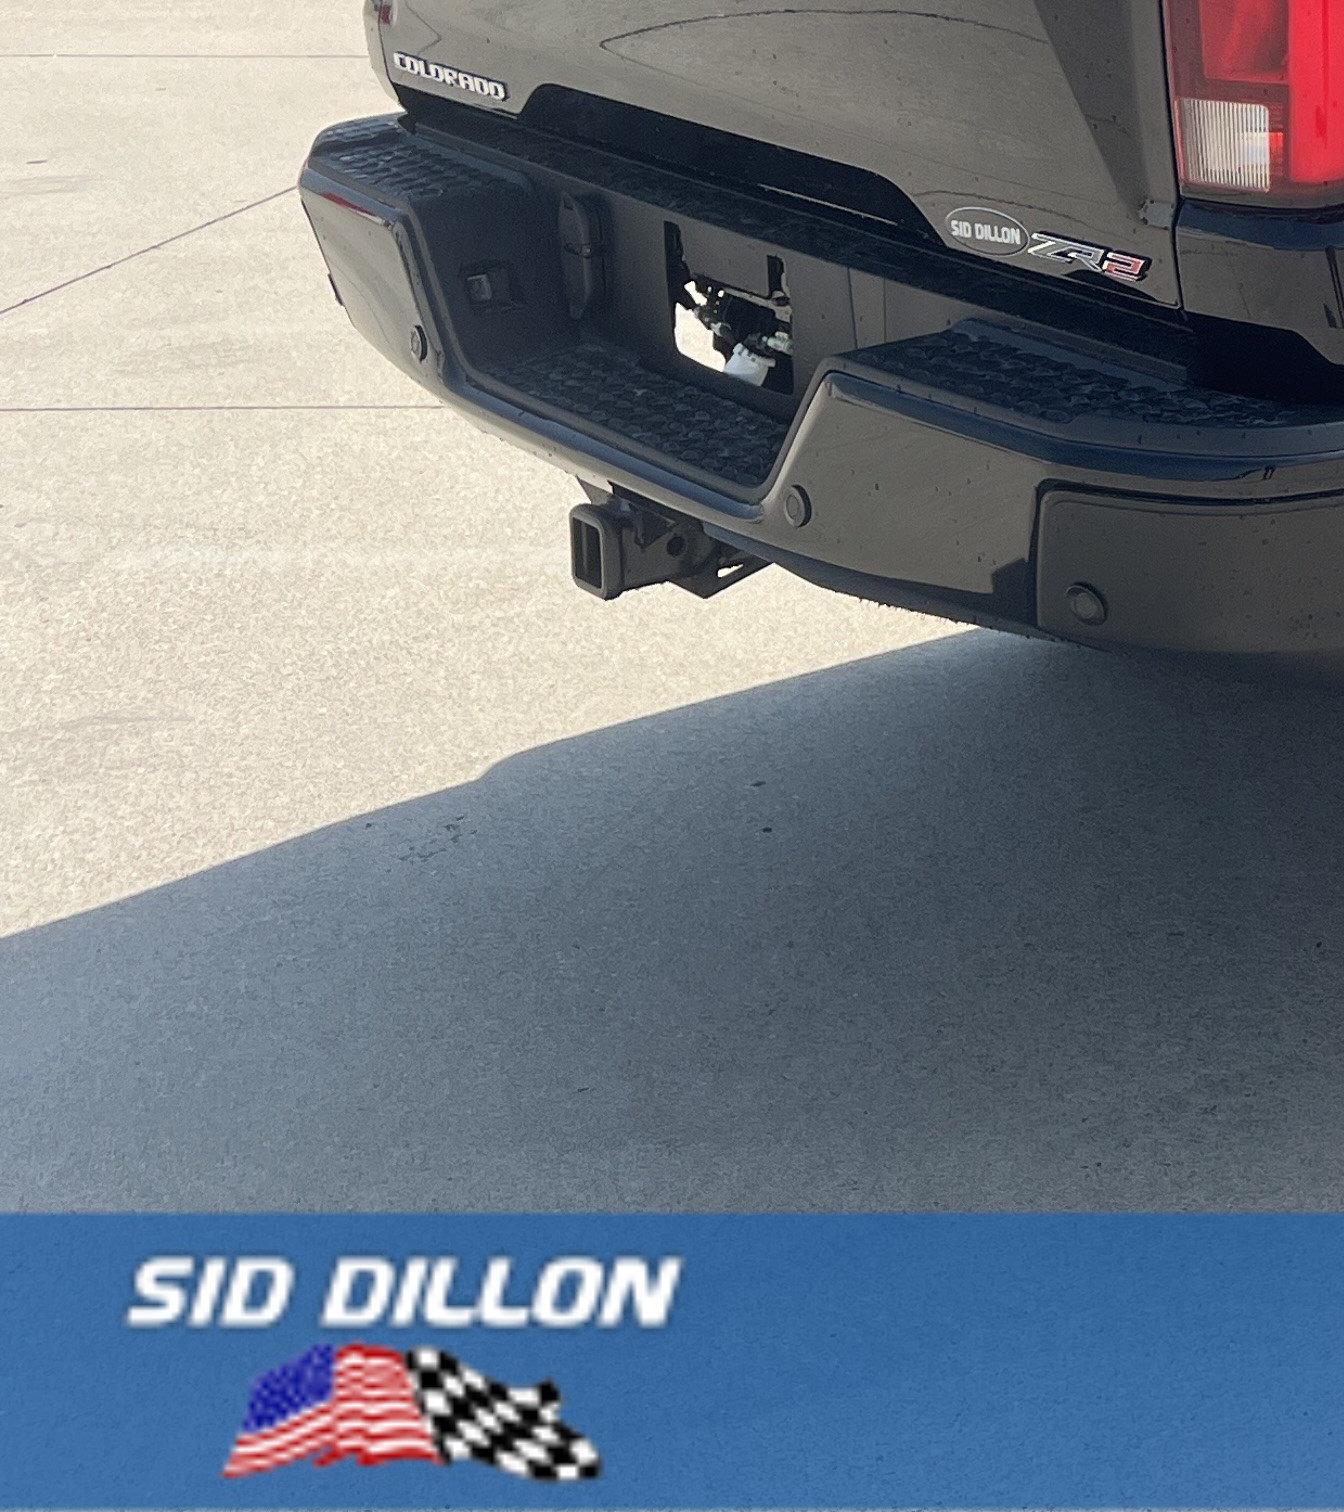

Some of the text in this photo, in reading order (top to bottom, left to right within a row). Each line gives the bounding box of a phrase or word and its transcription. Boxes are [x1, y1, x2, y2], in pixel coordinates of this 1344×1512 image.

[393, 51, 507, 101] COLORADO
[951, 220, 1022, 245] SID DILLON
[1027, 231, 1149, 282] ZR2
